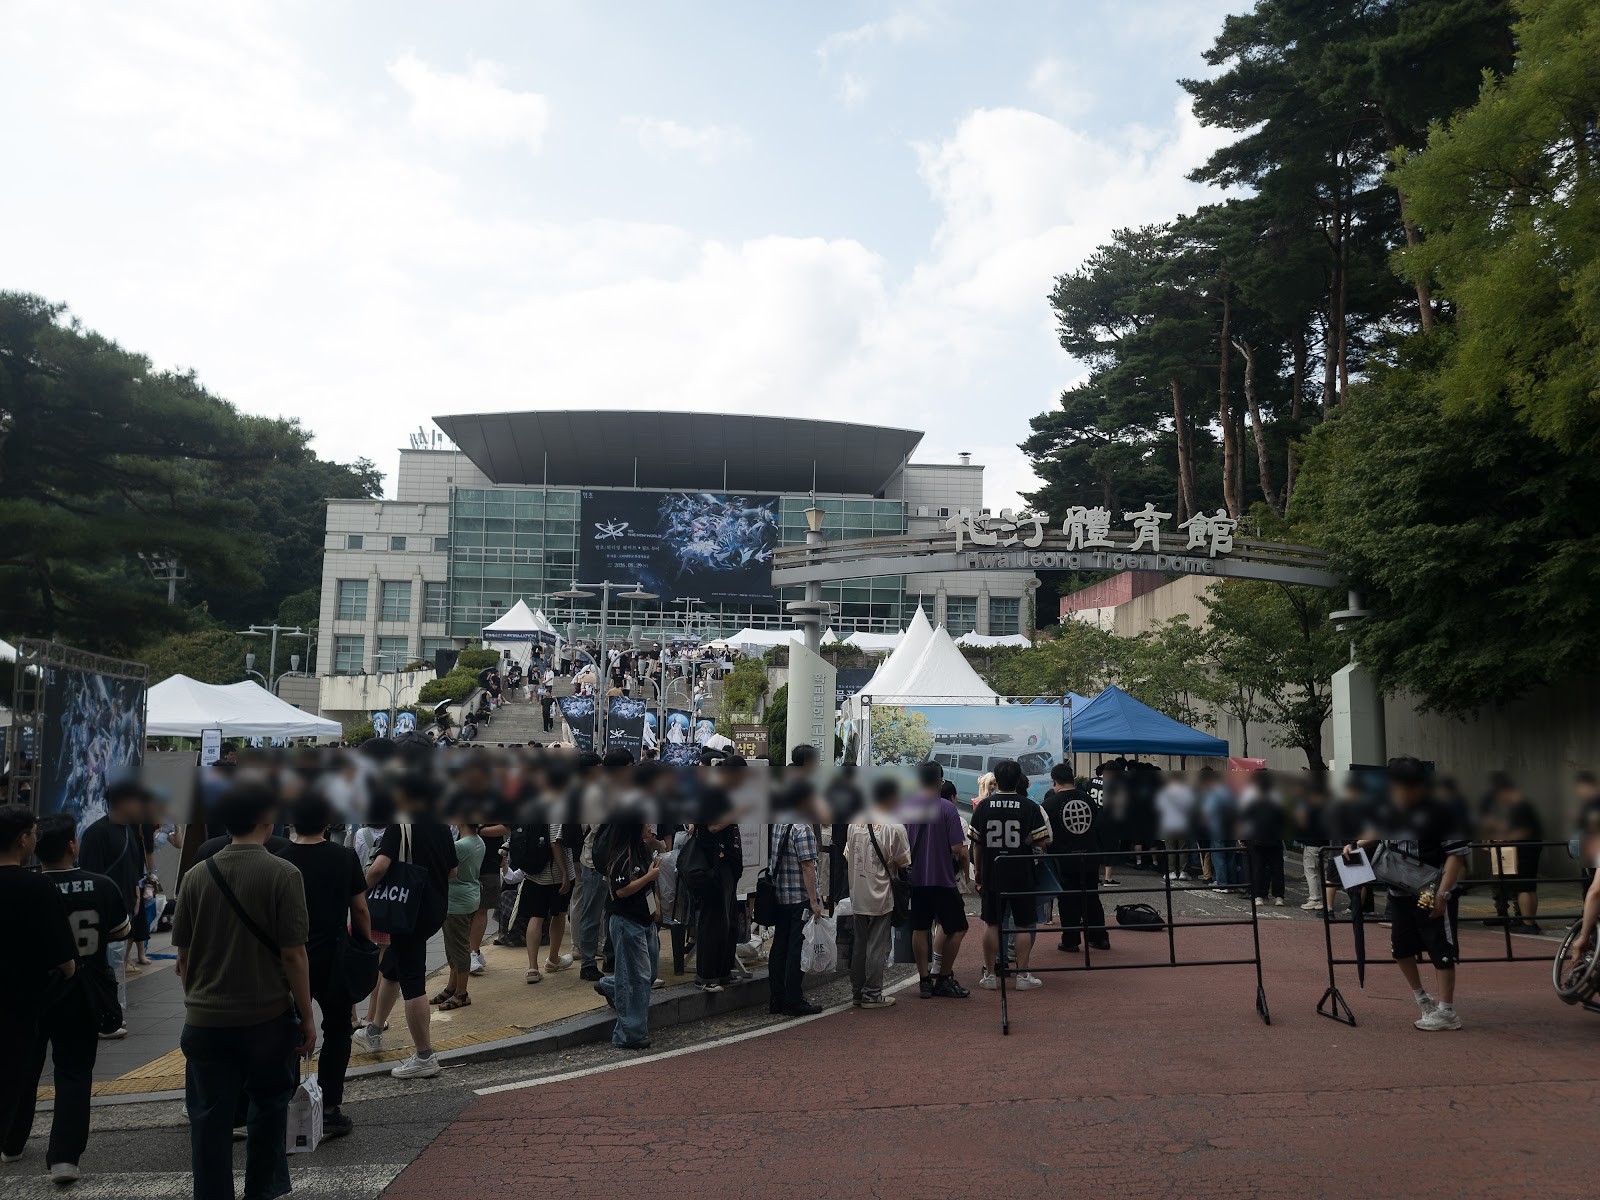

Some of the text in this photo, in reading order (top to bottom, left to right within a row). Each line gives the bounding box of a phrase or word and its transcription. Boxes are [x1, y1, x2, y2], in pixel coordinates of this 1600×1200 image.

[965, 551, 1216, 573] Hwa Jeong Tiger Dome
[737, 743, 757, 756] 식당
[990, 800, 1020, 809] ROVER
[986, 819, 1021, 848] 26
[68, 909, 100, 957] 6
